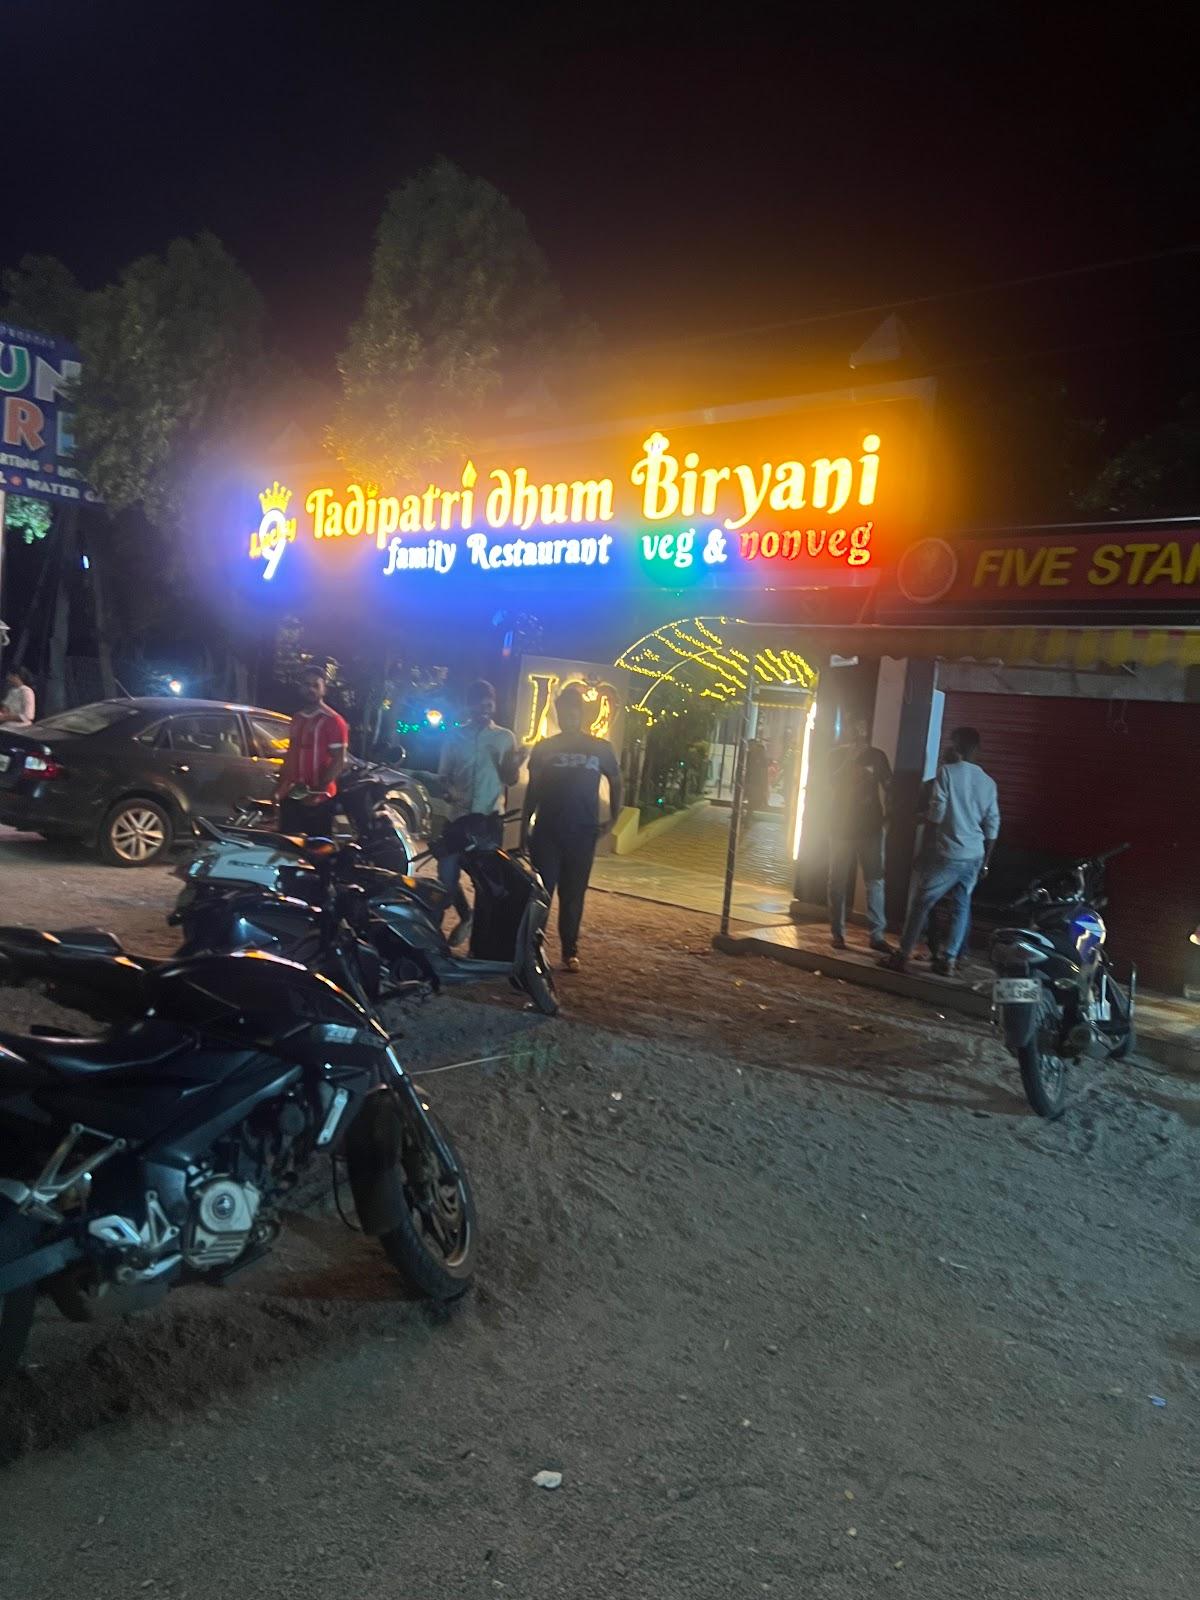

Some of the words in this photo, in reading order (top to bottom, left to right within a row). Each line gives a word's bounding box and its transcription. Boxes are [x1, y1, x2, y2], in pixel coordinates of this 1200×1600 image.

[26, 477, 80, 499] WATER
[305, 460, 477, 549] Tadipatri
[486, 467, 614, 530] dhum
[631, 432, 881, 530] Biryani
[383, 536, 457, 575] family
[466, 532, 614, 570] Restaurant
[641, 528, 696, 568] veg
[703, 528, 728, 565] &
[740, 521, 873, 566] nonveg
[971, 546, 1079, 588] FIVE
